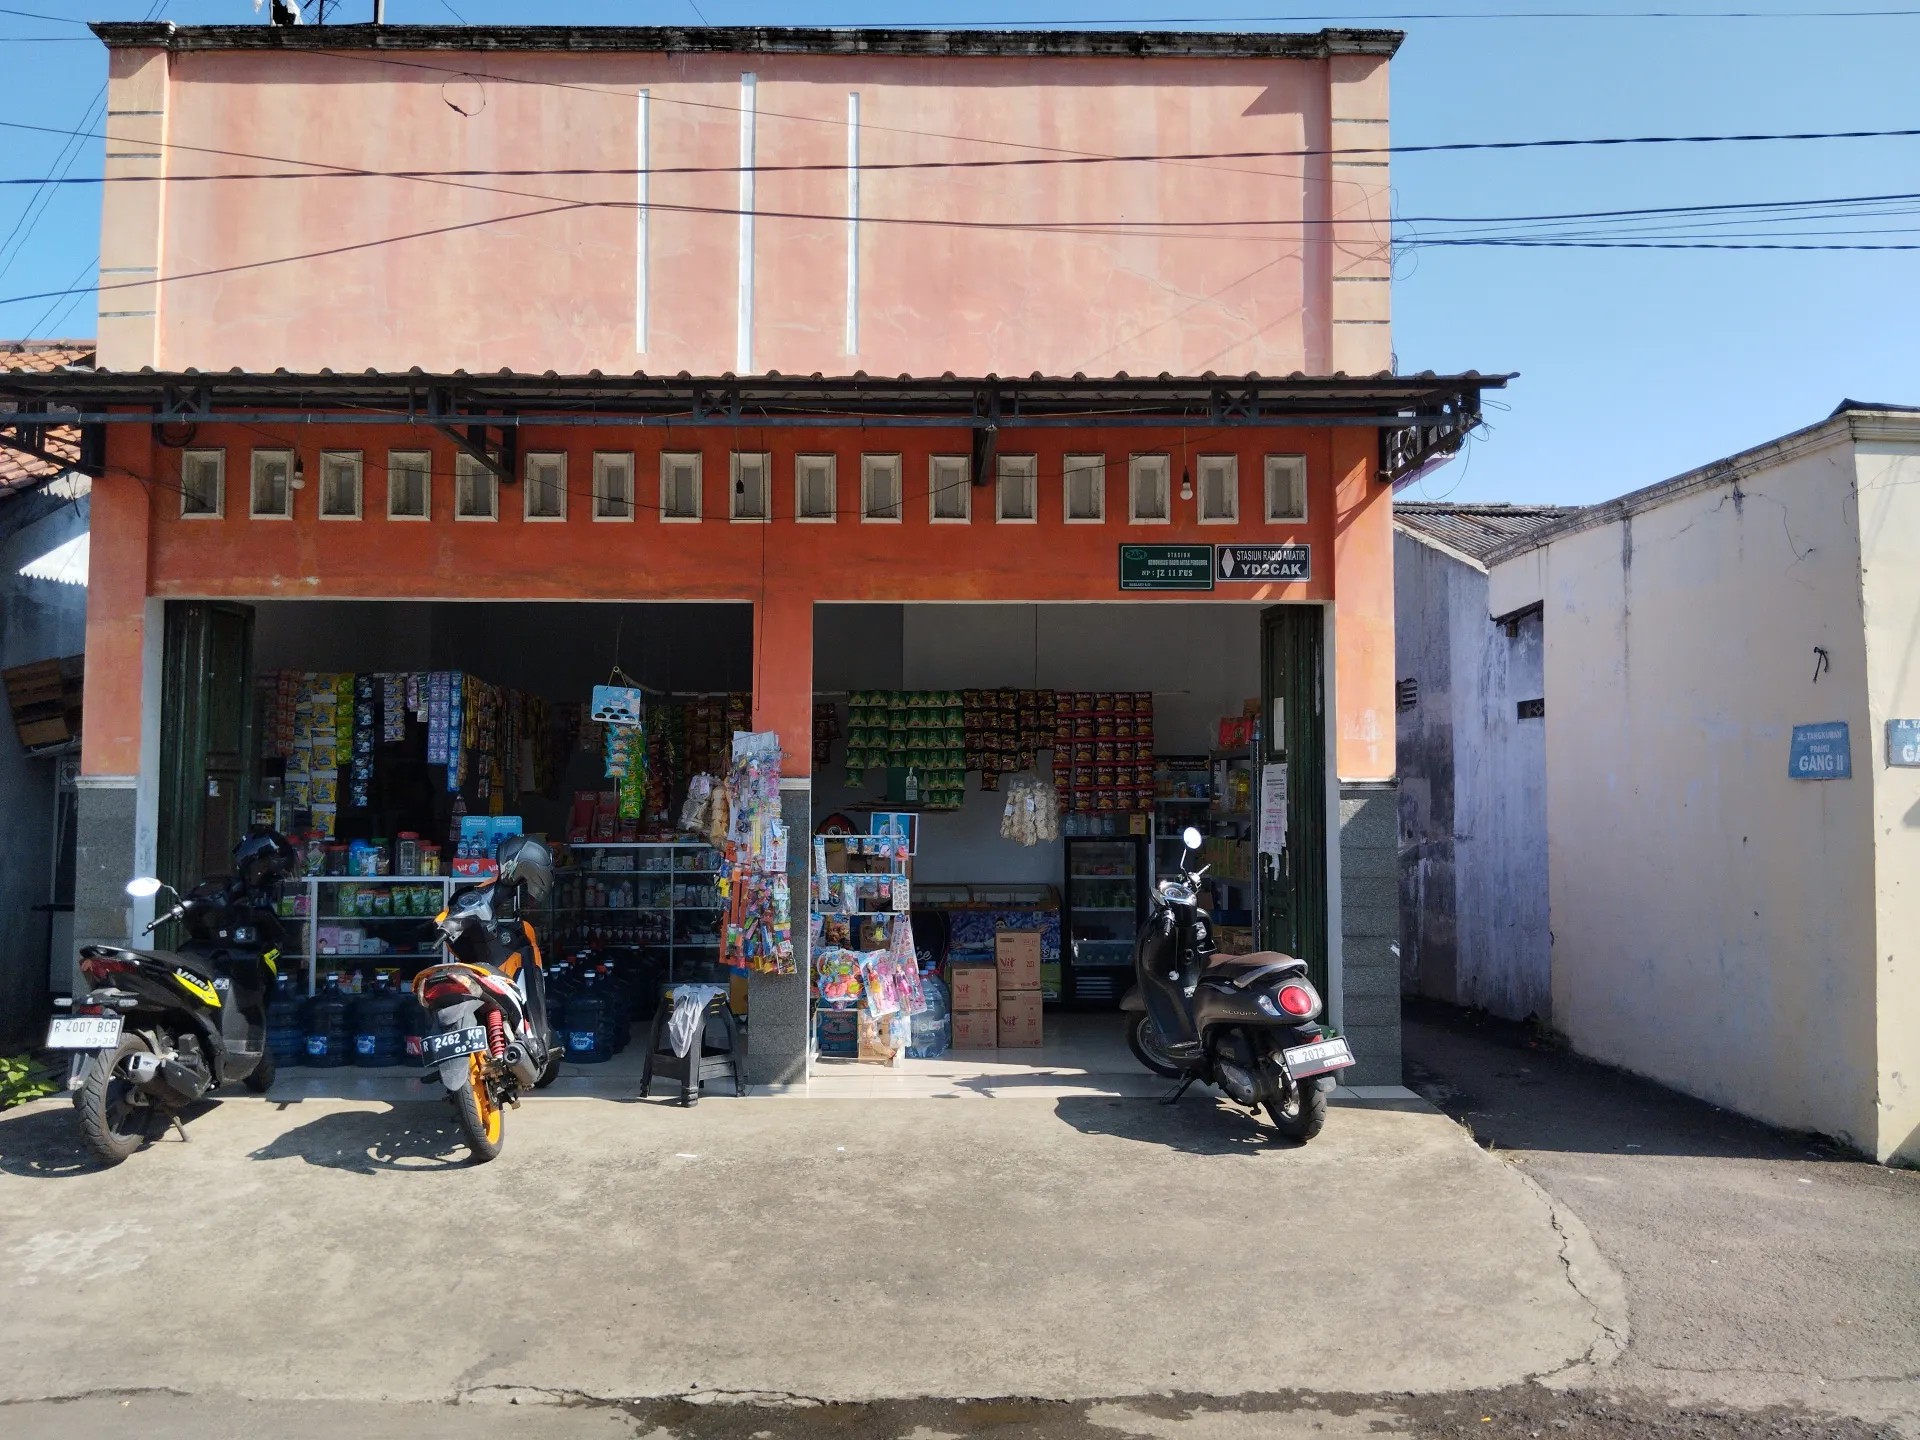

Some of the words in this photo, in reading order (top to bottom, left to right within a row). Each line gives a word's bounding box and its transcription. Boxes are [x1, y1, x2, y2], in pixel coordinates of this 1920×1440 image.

[1237, 551, 1260, 561] STASIUN
[1263, 550, 1282, 561] RADIO
[1283, 550, 1305, 561] AMATIR
[1156, 569, 1165, 579] JZ
[1178, 569, 1193, 577] FUS
[1241, 563, 1302, 575] YD2CAK
[1807, 730, 1842, 740] TANGKUBAN
[1799, 754, 1834, 771] GANG
[1000, 957, 1016, 968] Vit
[54, 1021, 61, 1033] R
[66, 1021, 92, 1033] 4007
[97, 1021, 117, 1033] BCB
[422, 1041, 429, 1052] R
[434, 1033, 460, 1049] 2462
[467, 1029, 482, 1040] KP
[1288, 1054, 1296, 1066] R
[1303, 1047, 1326, 1061] 2073
